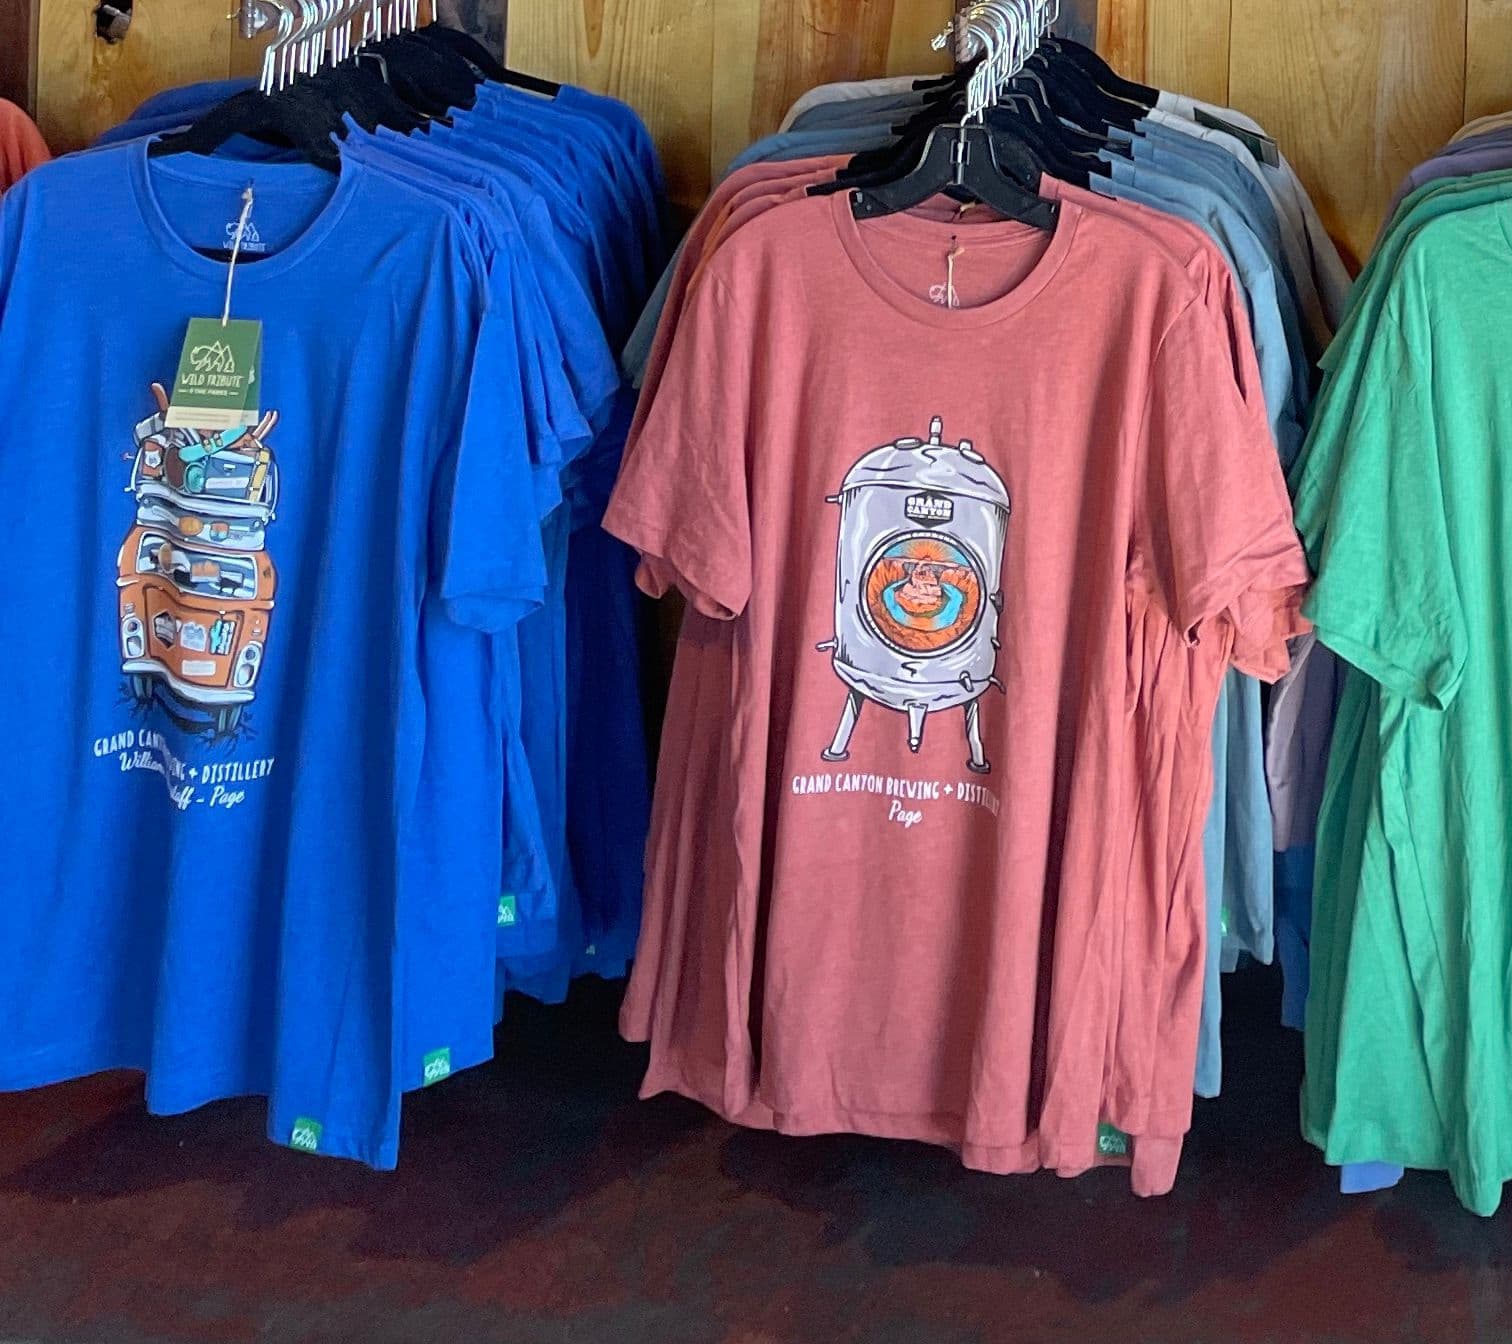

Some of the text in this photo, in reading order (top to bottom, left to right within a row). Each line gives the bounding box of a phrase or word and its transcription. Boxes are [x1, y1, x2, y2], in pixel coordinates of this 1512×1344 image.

[181, 373, 244, 388] WILD TRIBUTE
[906, 506, 952, 517] CANYON
[907, 496, 952, 509] GRAND
[93, 729, 135, 757] GRAND
[201, 757, 276, 785] DISTILLERY
[209, 784, 245, 810] Page
[792, 773, 832, 795] GRAND
[835, 773, 884, 794] CANYON
[886, 776, 940, 800] BREWING
[888, 799, 923, 828] Page
